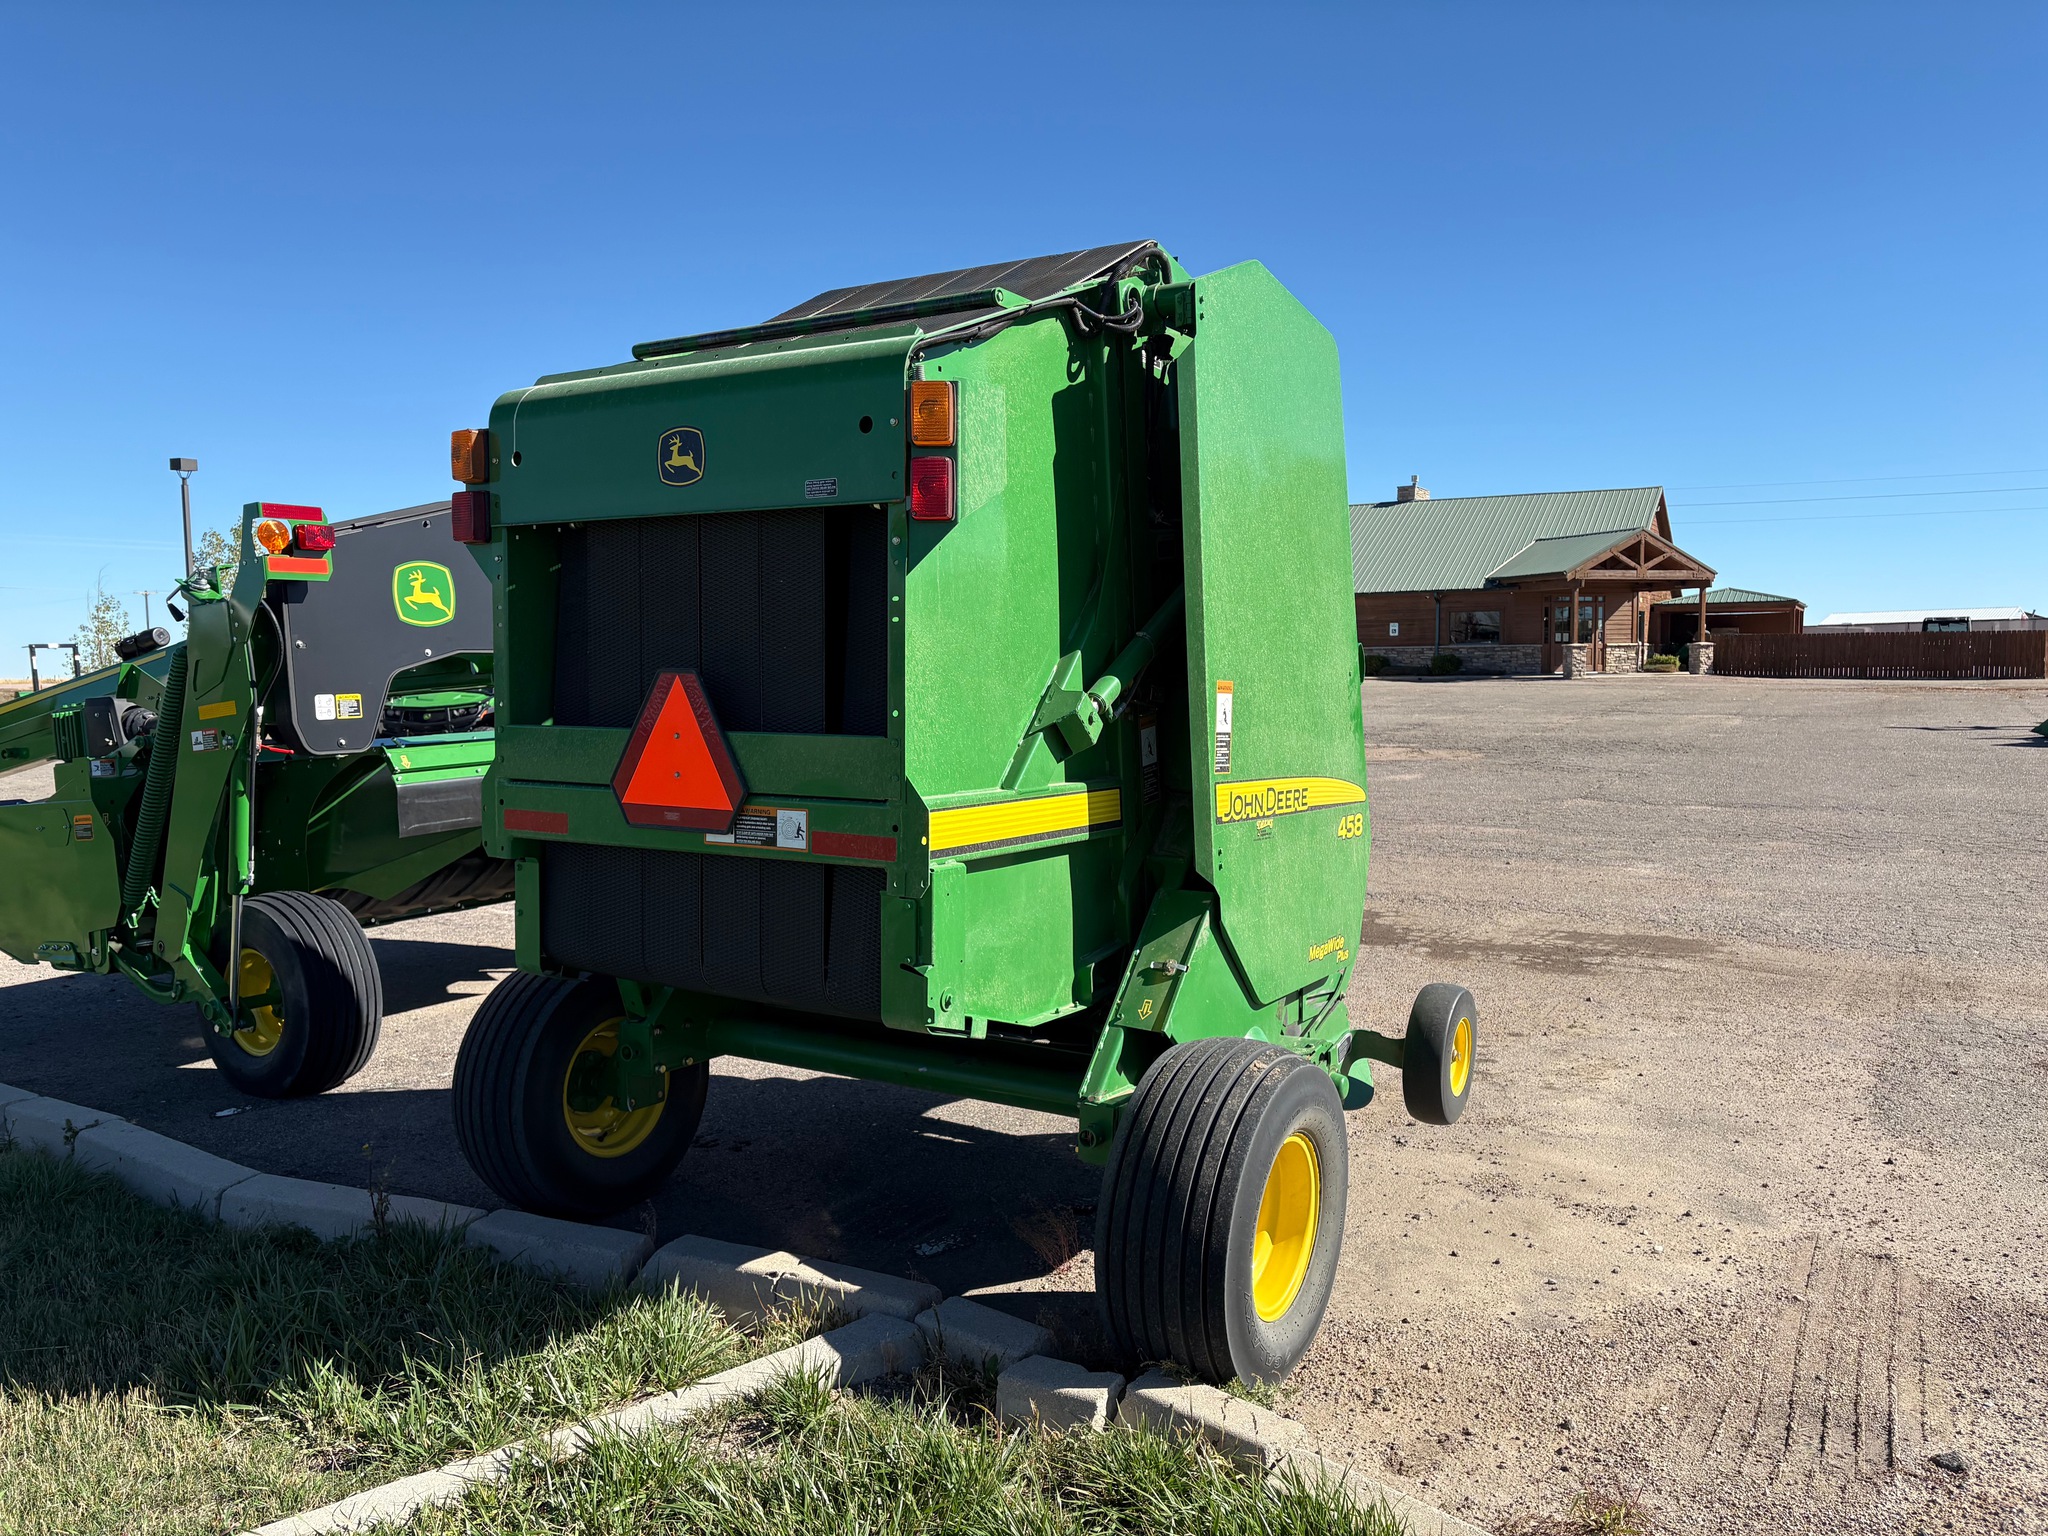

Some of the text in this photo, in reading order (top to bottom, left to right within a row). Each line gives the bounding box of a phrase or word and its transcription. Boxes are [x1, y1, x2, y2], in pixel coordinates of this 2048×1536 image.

[745, 807, 771, 815] WARNING
[1224, 788, 1308, 818] JOHN DEERE
[1338, 813, 1363, 840] 458
[1308, 934, 1345, 963] MegaWide
[1336, 949, 1350, 964] Plus
